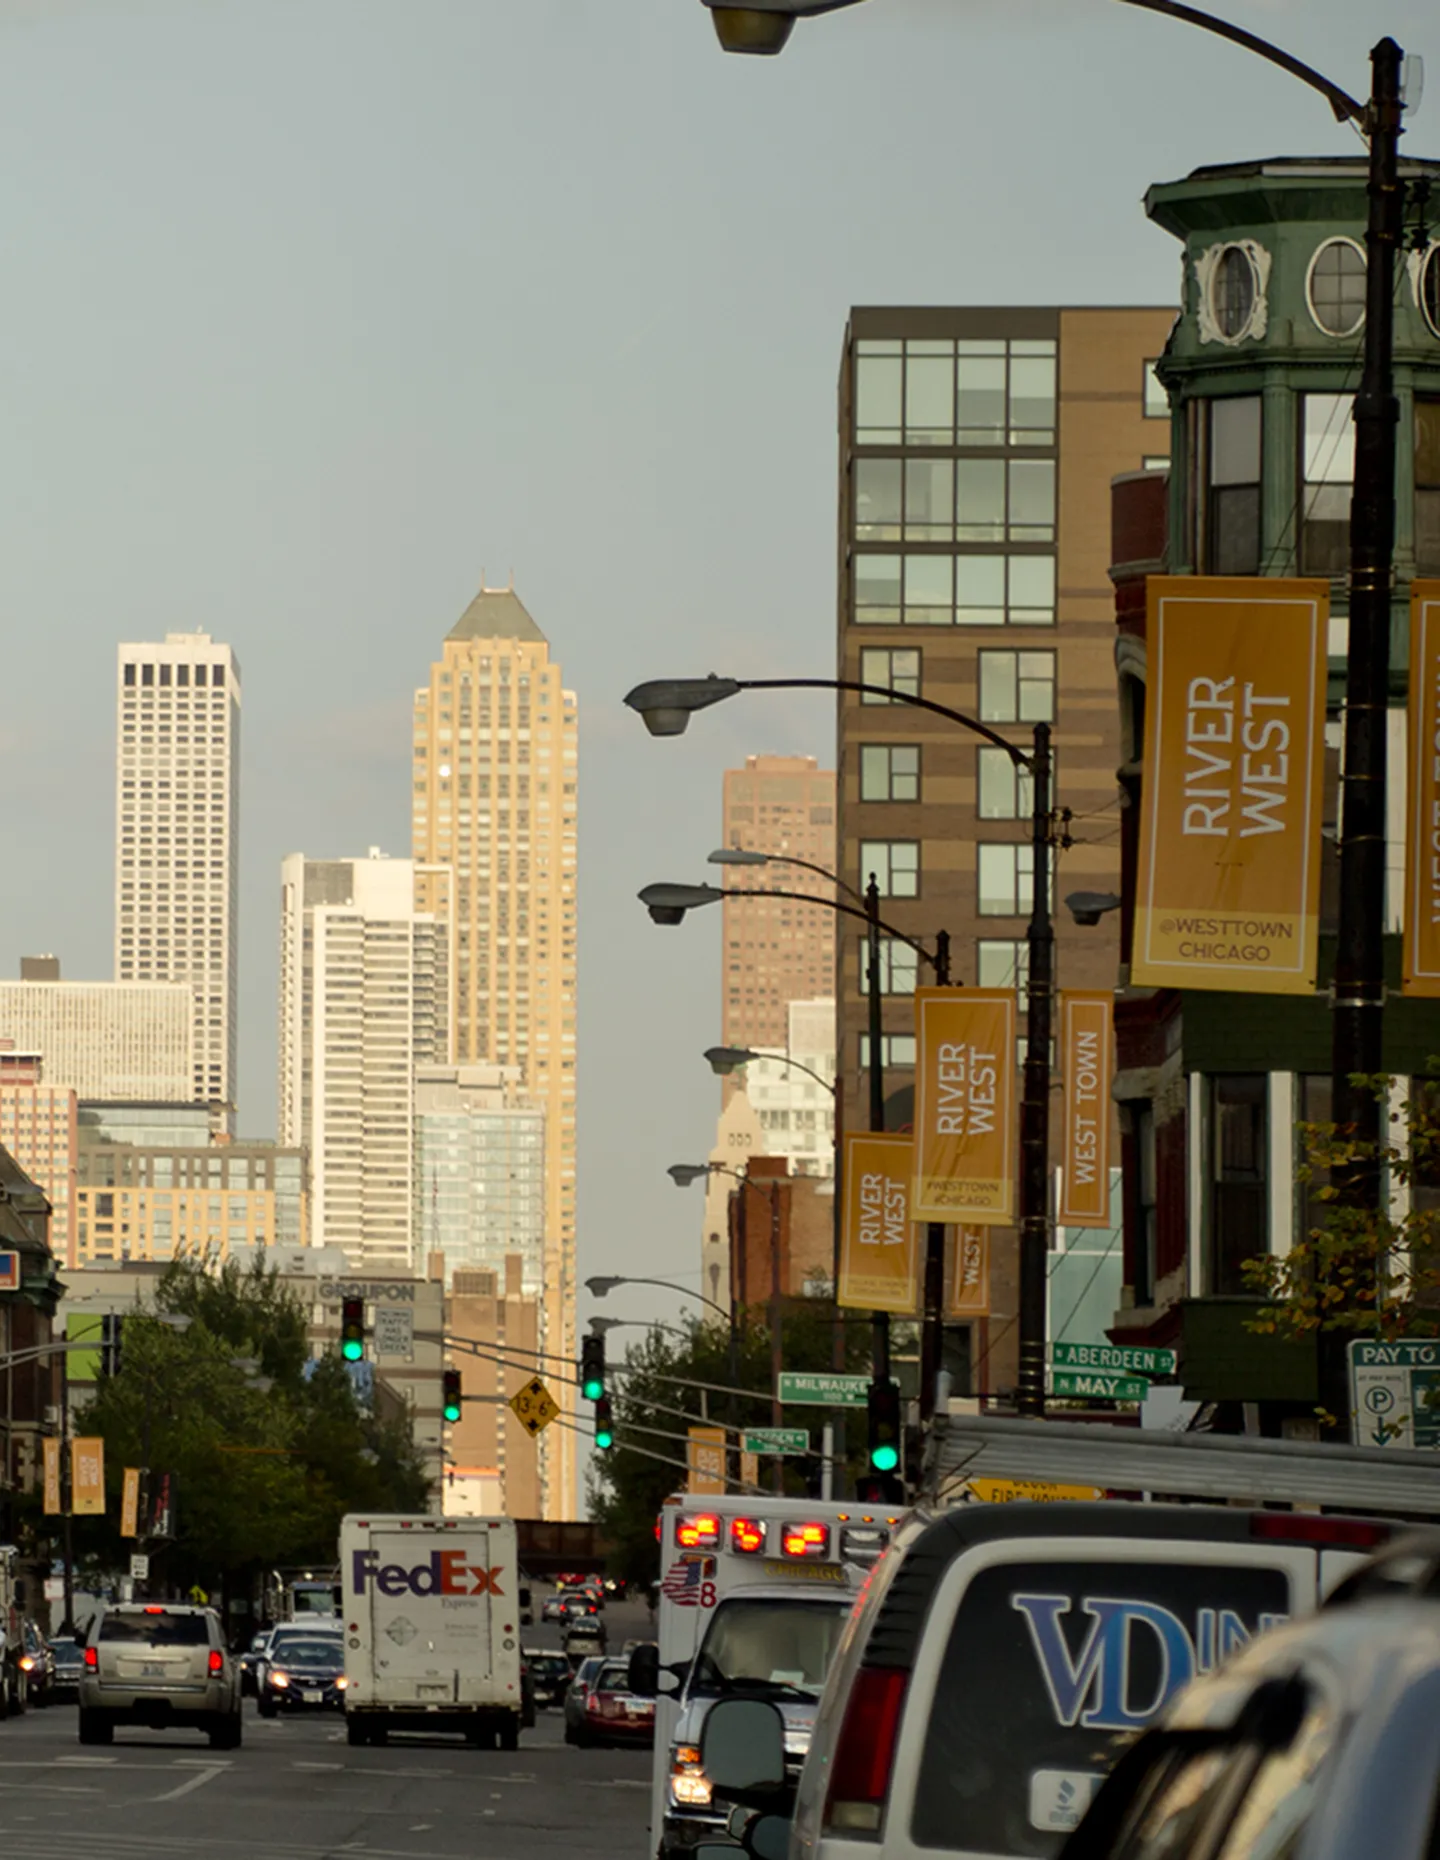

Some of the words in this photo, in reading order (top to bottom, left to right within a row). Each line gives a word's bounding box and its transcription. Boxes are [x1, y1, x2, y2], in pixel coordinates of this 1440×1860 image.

[1182, 675, 1236, 838] RIVER
[1240, 682, 1290, 838] WEST
[1159, 918, 1293, 939] @WESTTOWN
[1179, 942, 1271, 963] CHICAGO
[937, 1042, 966, 1134] RIVER
[968, 1046, 996, 1135] WEST
[1077, 1031, 1098, 1105] TOWN
[1075, 1114, 1096, 1185] WEST
[859, 1173, 883, 1245] RIVER
[884, 1178, 906, 1245] WEST
[963, 1233, 981, 1286] WEST
[320, 1284, 415, 1301] GROUPON
[1067, 1346, 1156, 1370] ABERDEEN
[1160, 1357, 1172, 1367] ST
[1362, 1347, 1400, 1363] PAY
[1405, 1346, 1436, 1363] TO
[795, 1378, 868, 1393] MILWAUKE
[1059, 1378, 1069, 1389] N
[1075, 1375, 1119, 1396] MAY
[1126, 1383, 1141, 1394] ST
[352, 1550, 505, 1596] FedEx
[700, 1582, 717, 1607] 8
